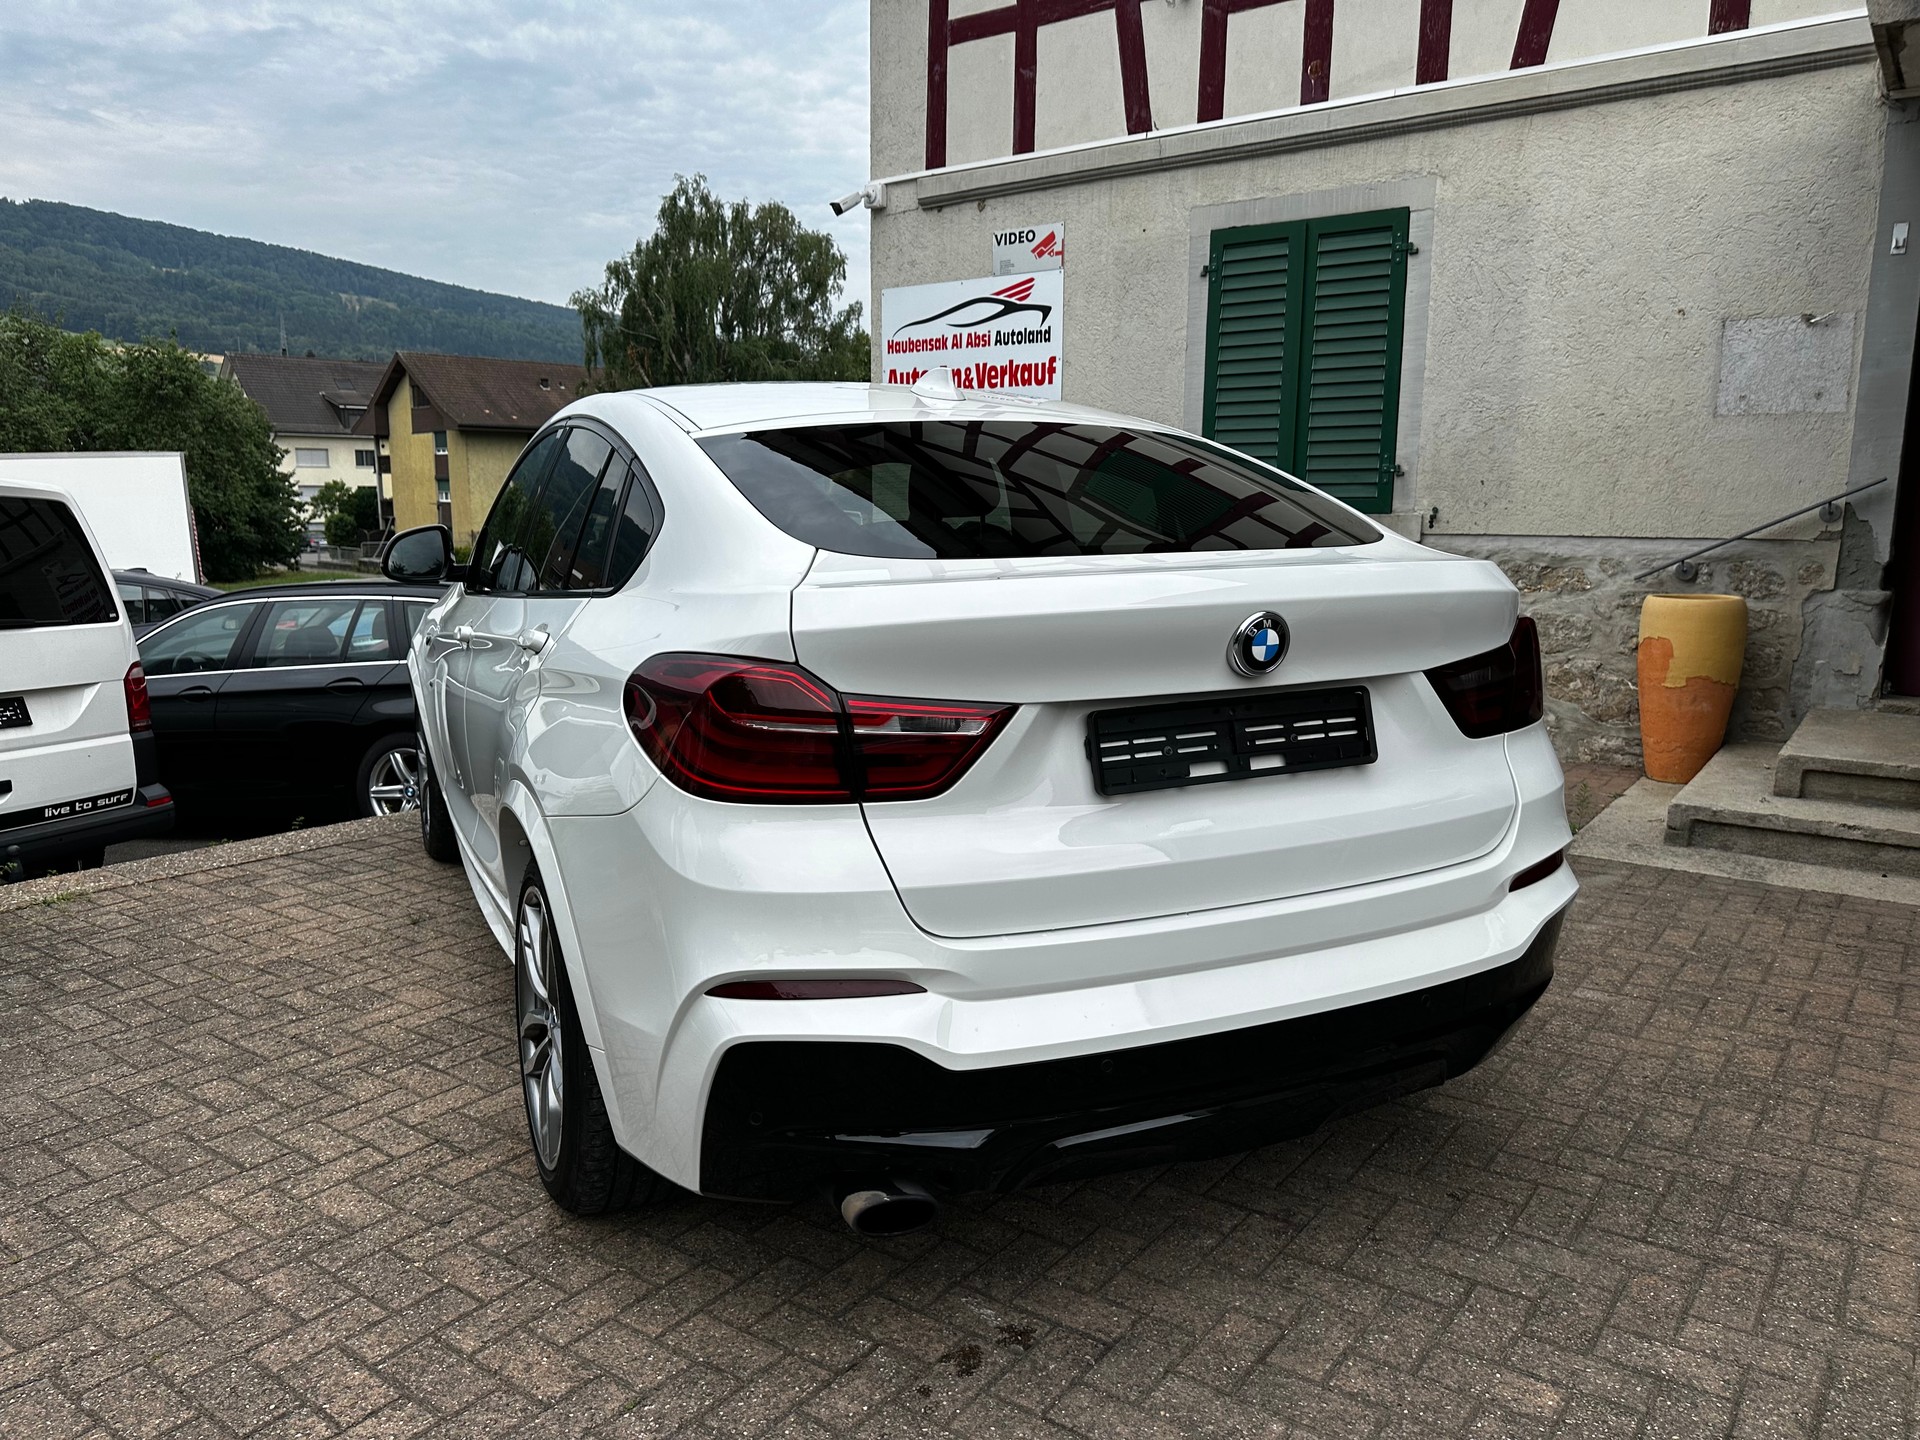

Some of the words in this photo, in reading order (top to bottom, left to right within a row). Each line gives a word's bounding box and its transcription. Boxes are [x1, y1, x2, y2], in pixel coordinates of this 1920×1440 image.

[995, 229, 1036, 246] VIDEO
[887, 335, 948, 354] Haubensak
[951, 335, 963, 350] Al
[966, 330, 991, 348] Absi
[994, 326, 1051, 346] Autoland
[888, 366, 929, 385] Aut
[44, 805, 70, 818] live
[75, 801, 92, 811] to
[97, 793, 129, 807] surf
